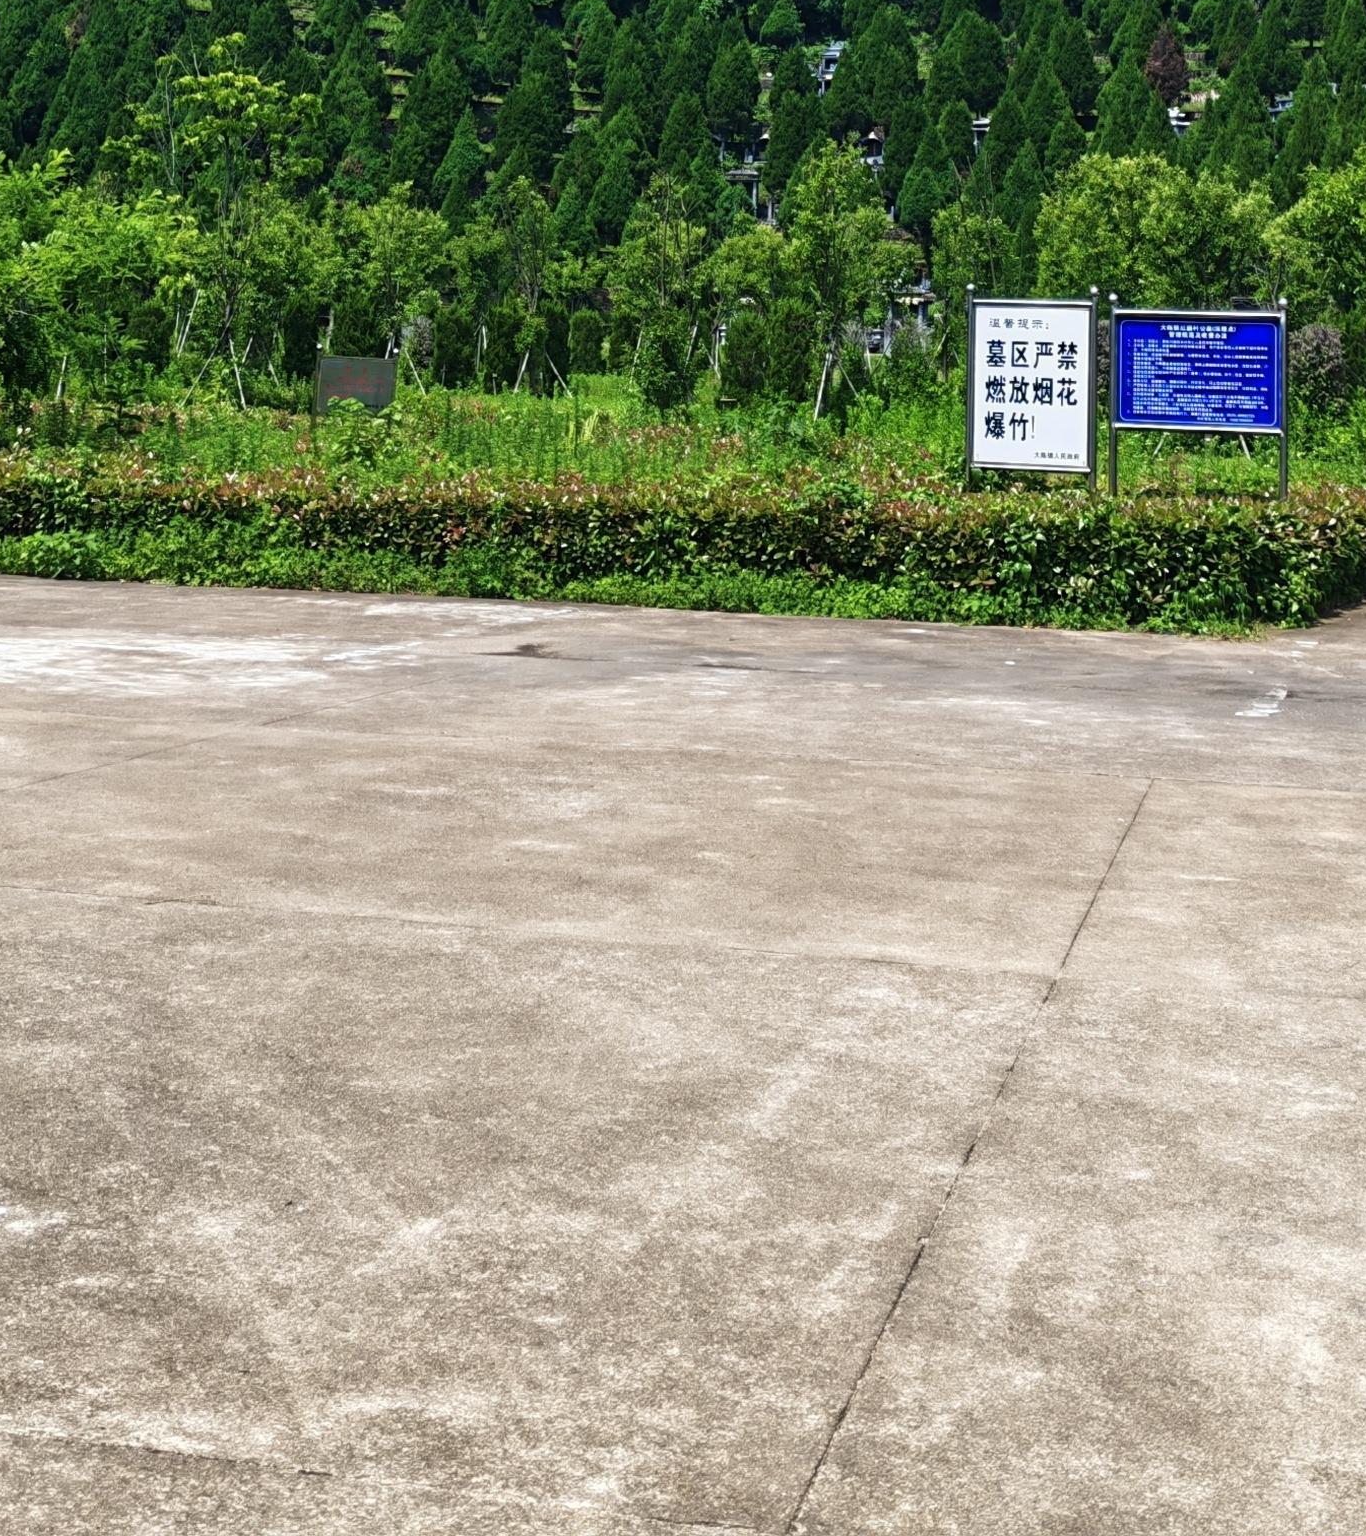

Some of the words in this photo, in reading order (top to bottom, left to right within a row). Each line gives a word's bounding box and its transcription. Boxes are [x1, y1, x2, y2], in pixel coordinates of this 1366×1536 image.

[986, 340, 1078, 371] 墓区严禁
[984, 375, 1078, 406] 燃放烟花
